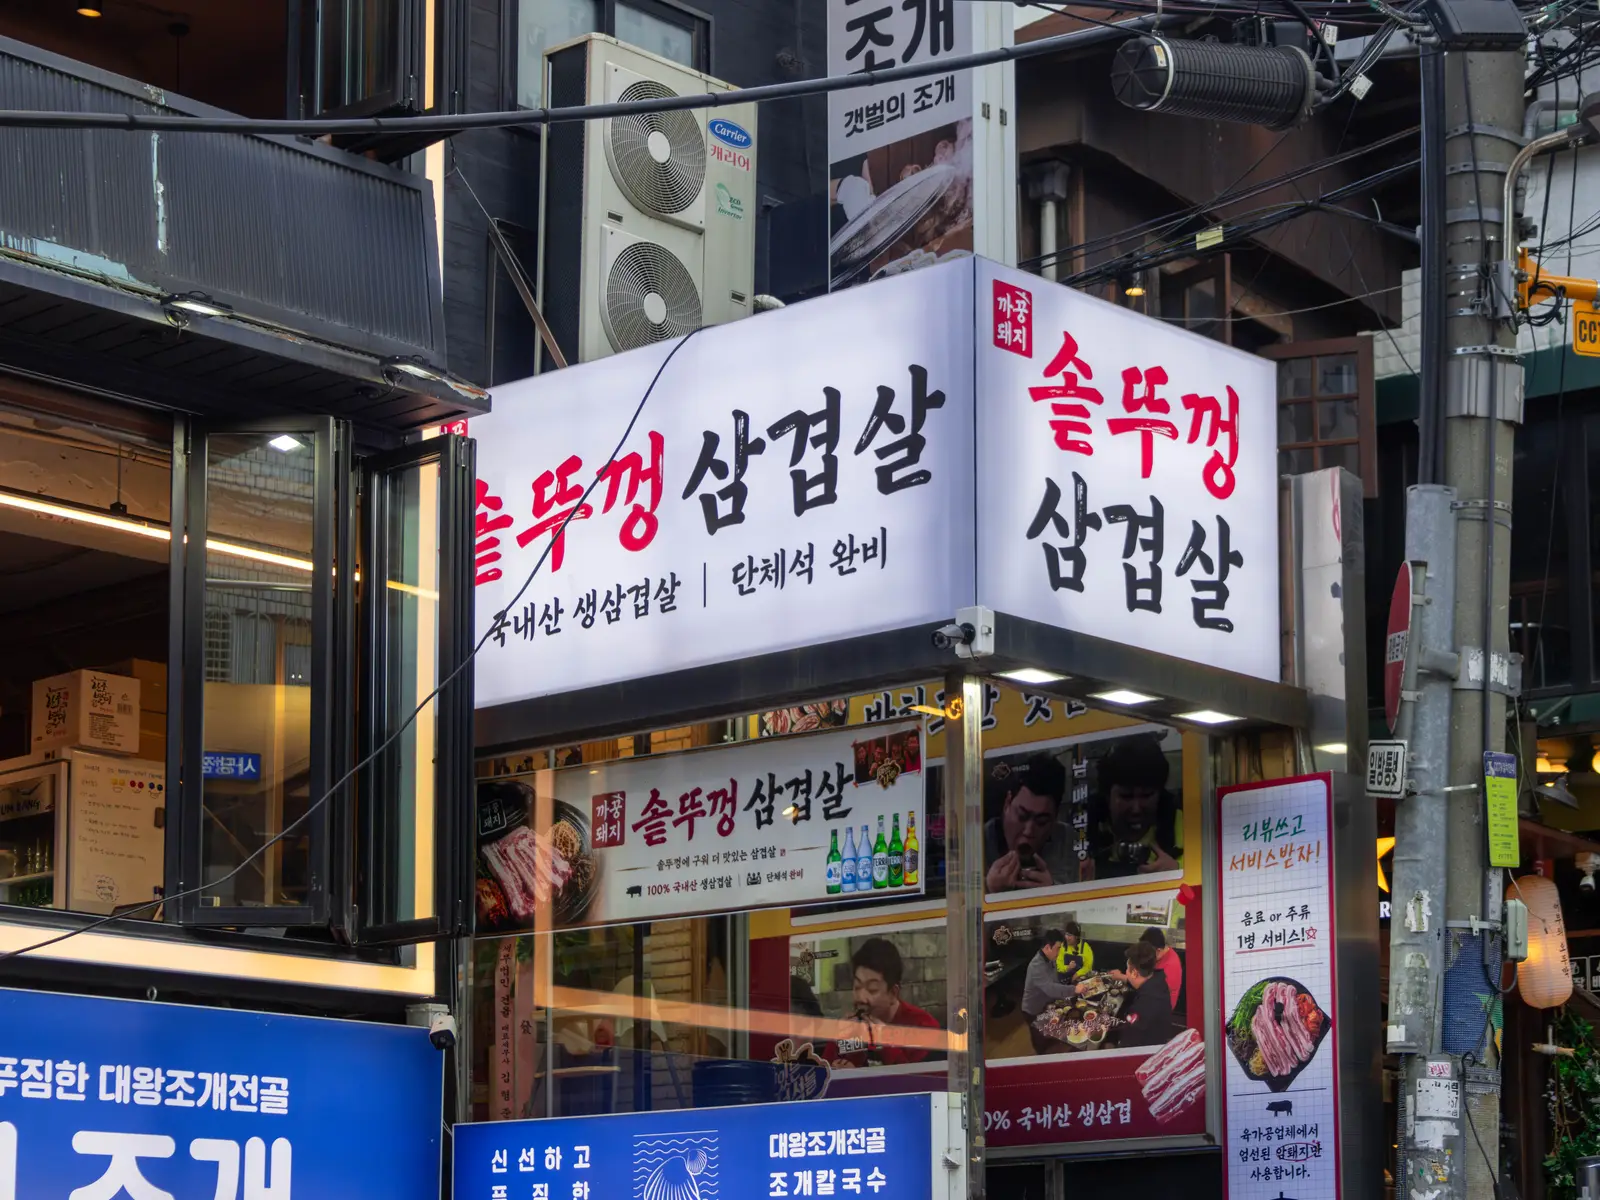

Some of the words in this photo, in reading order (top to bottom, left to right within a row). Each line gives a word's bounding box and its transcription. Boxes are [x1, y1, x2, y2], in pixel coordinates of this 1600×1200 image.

[845, 0, 953, 76] 조개
[844, 92, 906, 138] 갯벌의
[913, 75, 956, 115] 조개
[714, 123, 747, 143] Carrier
[711, 144, 750, 172] 캐리어
[996, 321, 1027, 351] 돼지
[1579, 319, 1600, 344] CC
[1028, 331, 1240, 500] 솥뚜껑
[682, 364, 946, 536] 삼겹살
[1026, 471, 1244, 633] 삼겹살
[488, 602, 565, 649] 국내산
[572, 572, 682, 631] 생삼겹살
[732, 542, 814, 597] 단체석
[829, 527, 888, 577] 완비
[631, 777, 738, 847] 솥뚜껑
[743, 762, 854, 830] 삼겹살
[595, 821, 621, 843] 돼지
[1242, 814, 1306, 843] 리뷰쓰고
[656, 857, 690, 872] 솥뚜껑에
[692, 854, 709, 867] 구워
[712, 853, 720, 865] 더
[722, 850, 748, 865] 맛있는
[750, 846, 777, 861] 삼겹살
[1229, 840, 1321, 872] 서비스받자!
[646, 883, 671, 896] 100%
[672, 879, 698, 894] 국내산
[700, 875, 733, 891] 생삼겹살
[766, 870, 788, 883] 단체석
[789, 868, 804, 880] 완비
[1240, 910, 1265, 927] 음료
[1269, 912, 1282, 923] or
[1285, 904, 1311, 922] 주류
[1237, 932, 1256, 950] 1병
[1261, 927, 1305, 948] 서비스!
[98, 1064, 290, 1115] 대왕조개전골
[1016, 1103, 1072, 1131] 국내산
[1077, 1098, 1132, 1127] 생삼겹
[769, 1127, 886, 1159] 대왕조개전골
[1240, 1123, 1319, 1142] 육가공업체에서
[1239, 1146, 1271, 1162] 엄선된
[769, 1166, 887, 1197] 조개칼국수
[1250, 1164, 1311, 1181] 사용합니다.
